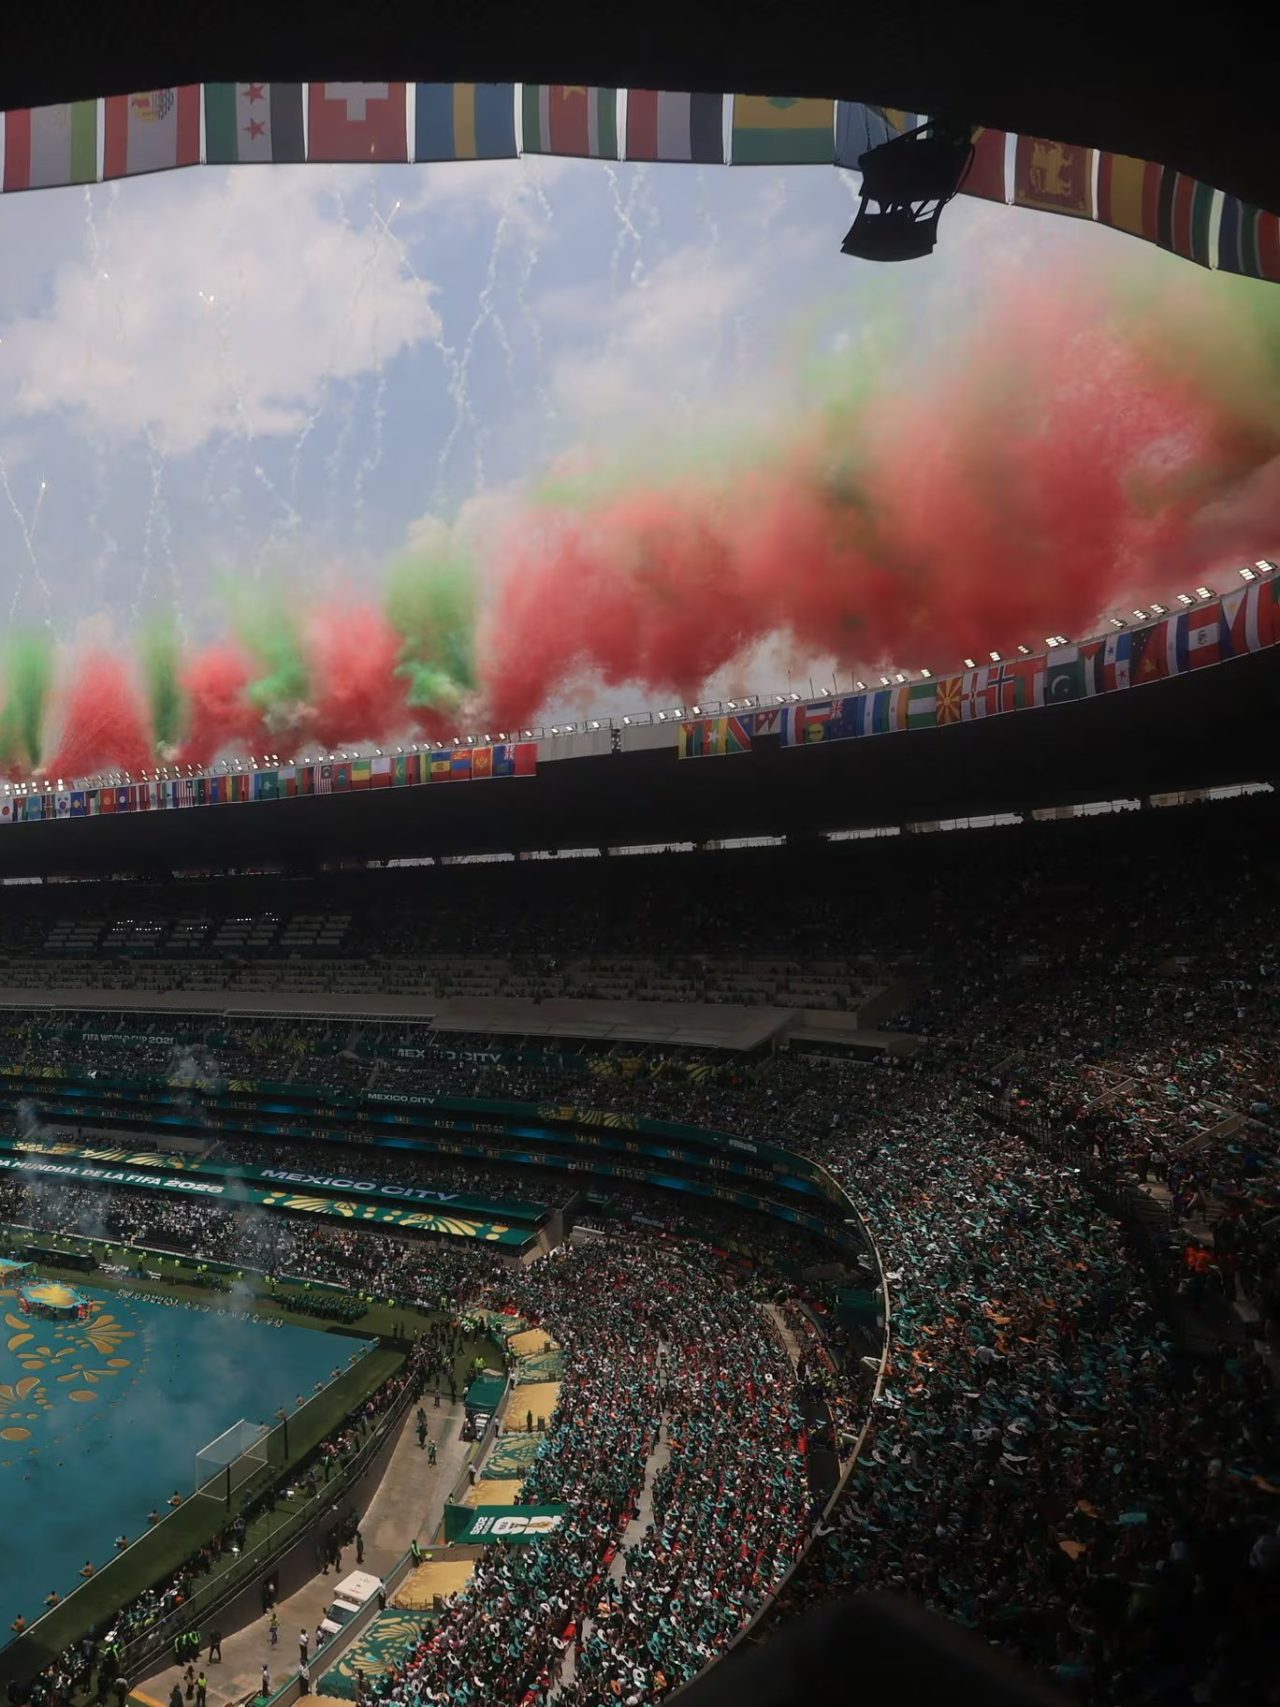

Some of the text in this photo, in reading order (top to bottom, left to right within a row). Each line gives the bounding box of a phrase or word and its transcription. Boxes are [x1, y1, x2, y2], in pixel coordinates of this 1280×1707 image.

[82, 1033, 99, 1042] FIFA
[367, 1093, 435, 1104] MEXICO CITY
[11, 1161, 79, 1174] MUNDIAL
[81, 1169, 103, 1178] DE
[103, 1171, 124, 1180] LA
[126, 1174, 161, 1185] FIFA
[163, 1180, 224, 1194] 2026
[260, 1169, 460, 1201] MEXICO CITY
